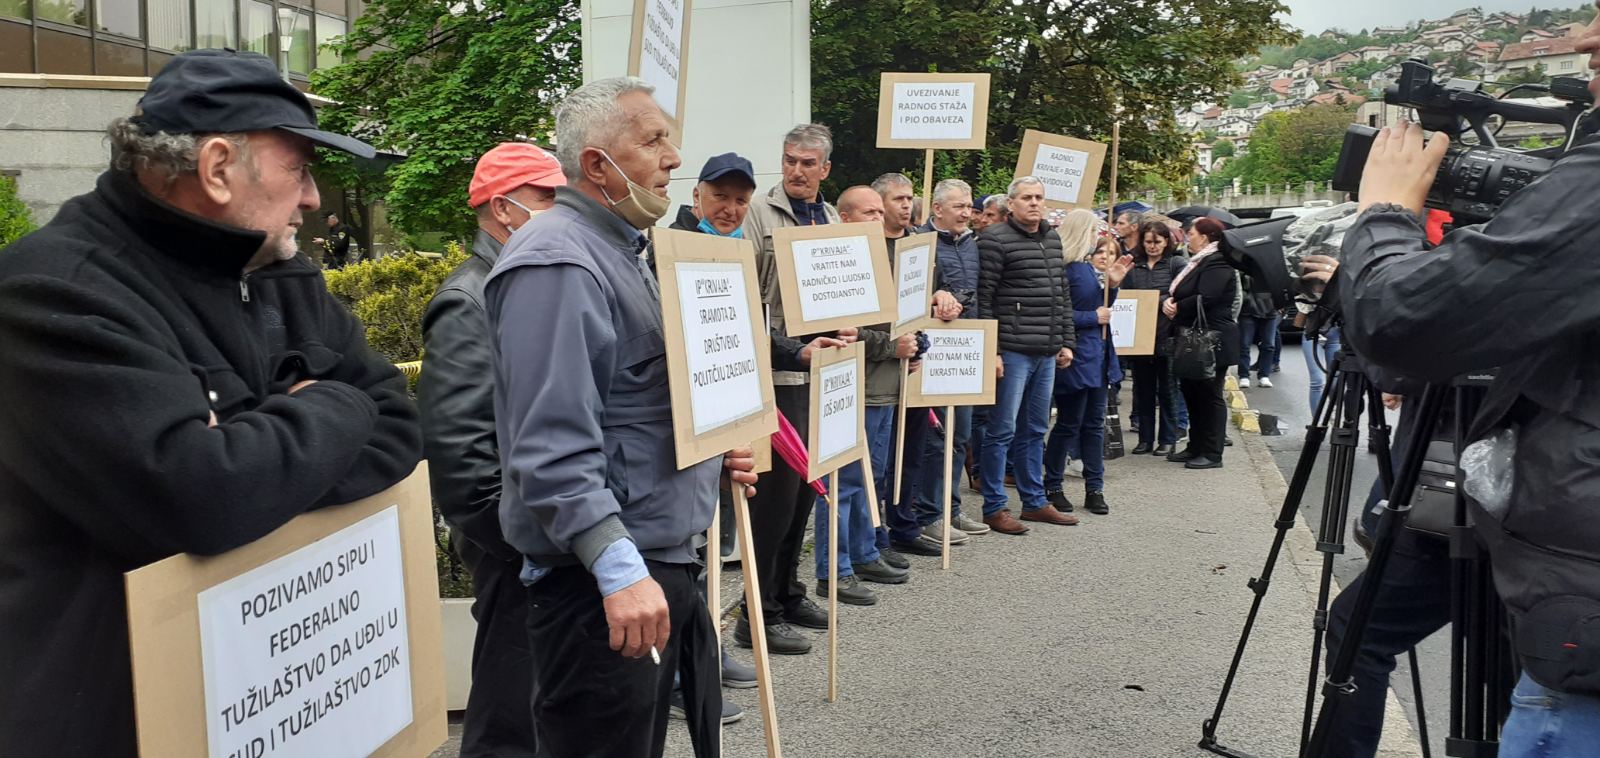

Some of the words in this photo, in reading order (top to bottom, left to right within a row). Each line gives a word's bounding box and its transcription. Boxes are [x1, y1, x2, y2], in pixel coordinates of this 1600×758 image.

[906, 88, 960, 97] UVEZIVANJE
[898, 102, 937, 110] RADNOG
[939, 101, 967, 110] STAŽA
[900, 115, 903, 123] I
[905, 115, 920, 123] PIO
[922, 115, 964, 123] OBAVEZA
[812, 261, 839, 271] VRATITE
[840, 259, 857, 268] NAM
[801, 275, 837, 287] RADNIČKO
[842, 272, 871, 283] LJUDSKO
[812, 287, 866, 301] DOSTOJANSTVO
[699, 307, 729, 325] SRAMOTA
[728, 306, 737, 321] ZA
[927, 352, 944, 361] NIKO
[946, 352, 962, 361] NAM
[964, 350, 980, 361] NEĆE
[930, 367, 958, 377] UKRASTI
[960, 365, 977, 376] NAŠE
[241, 561, 334, 625] POZIVAMO
[337, 543, 368, 577] SIPU
[370, 539, 375, 560] I
[270, 589, 361, 658] FEDERALNO
[221, 652, 326, 732] TUŽILAŠTVO
[330, 638, 353, 667] DA
[355, 616, 385, 651] UĐU
[388, 608, 398, 629] U
[229, 737, 265, 758] UD
[270, 728, 275, 751] I
[278, 666, 371, 743] TUŽILAŠTVO
[374, 646, 400, 680] ZDK
